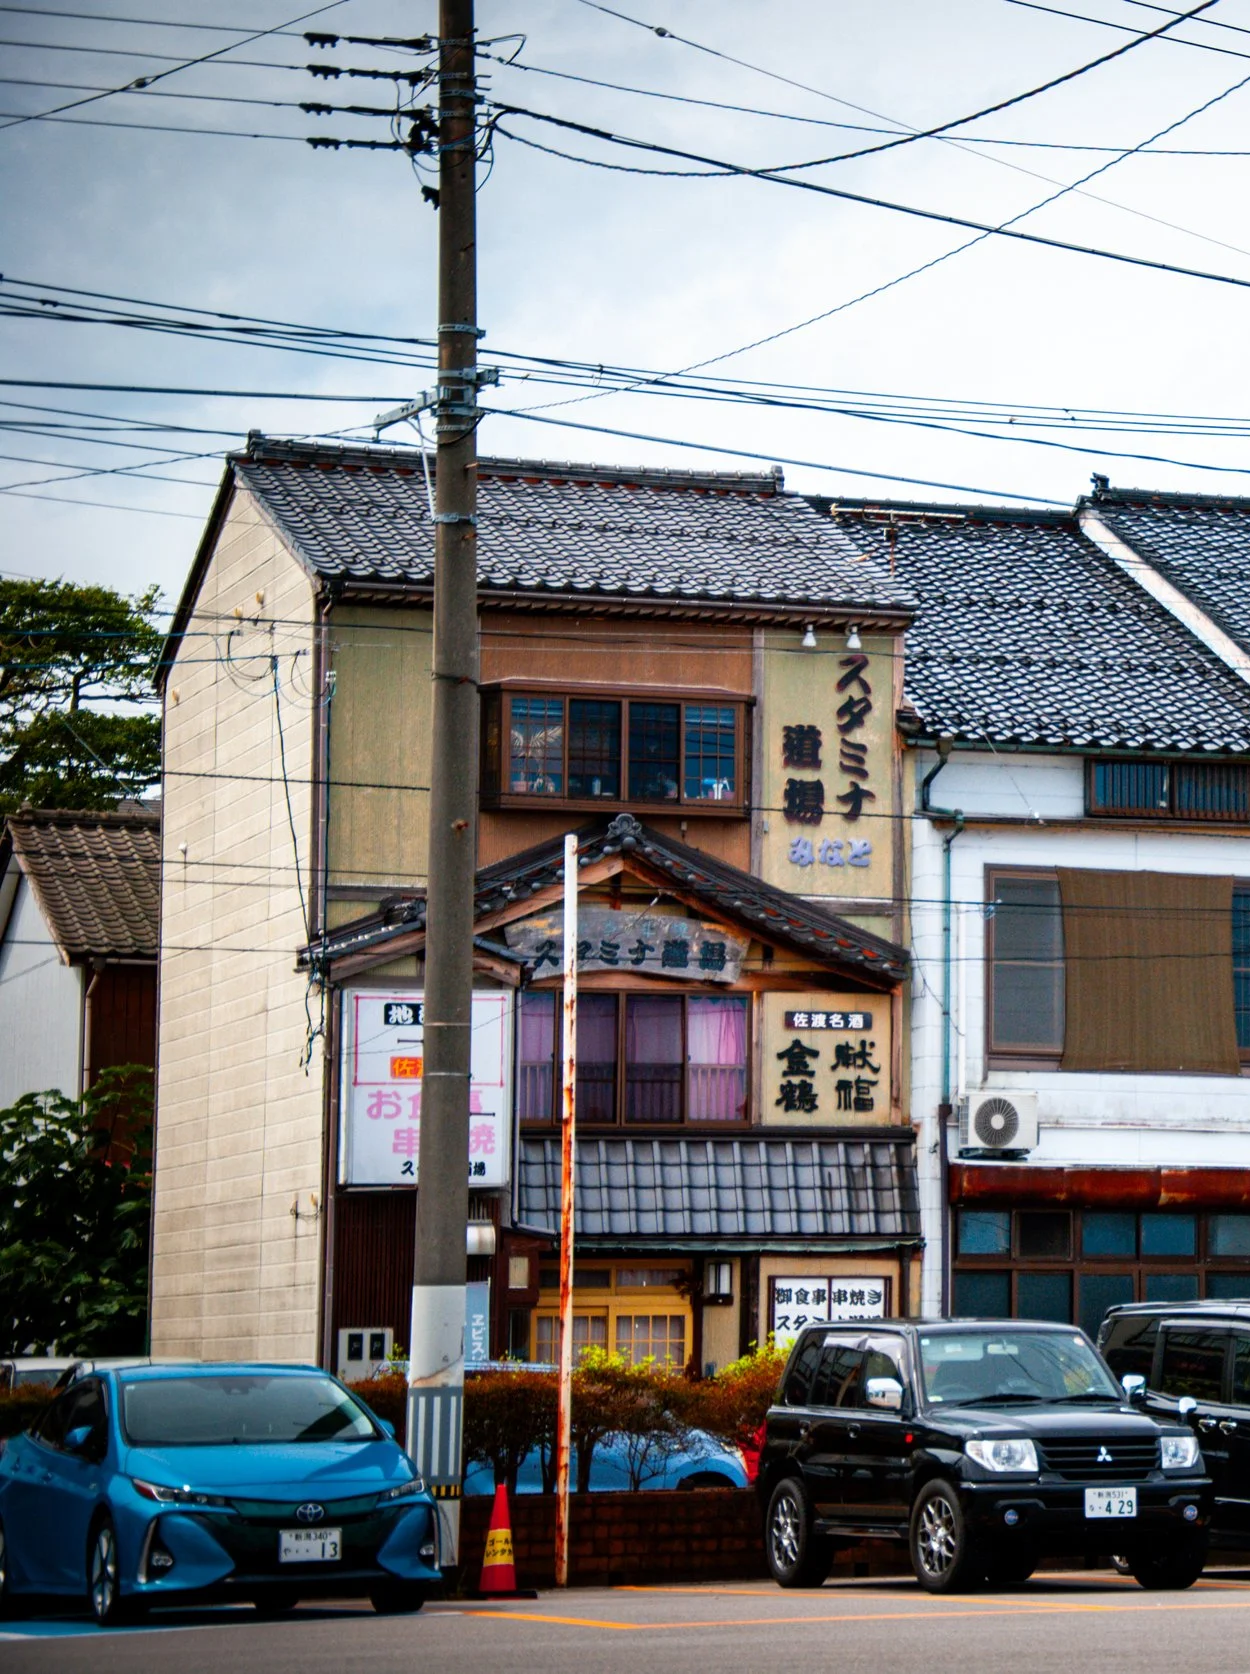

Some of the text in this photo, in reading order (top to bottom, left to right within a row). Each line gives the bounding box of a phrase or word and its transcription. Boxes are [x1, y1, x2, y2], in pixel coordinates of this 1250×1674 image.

[835, 654, 876, 822] スタミナ
[782, 724, 825, 827] 道場
[388, 1004, 424, 1024] 地
[793, 1012, 864, 1028] 佐渡名酒
[775, 1287, 883, 1306] 御食事 串焼き
